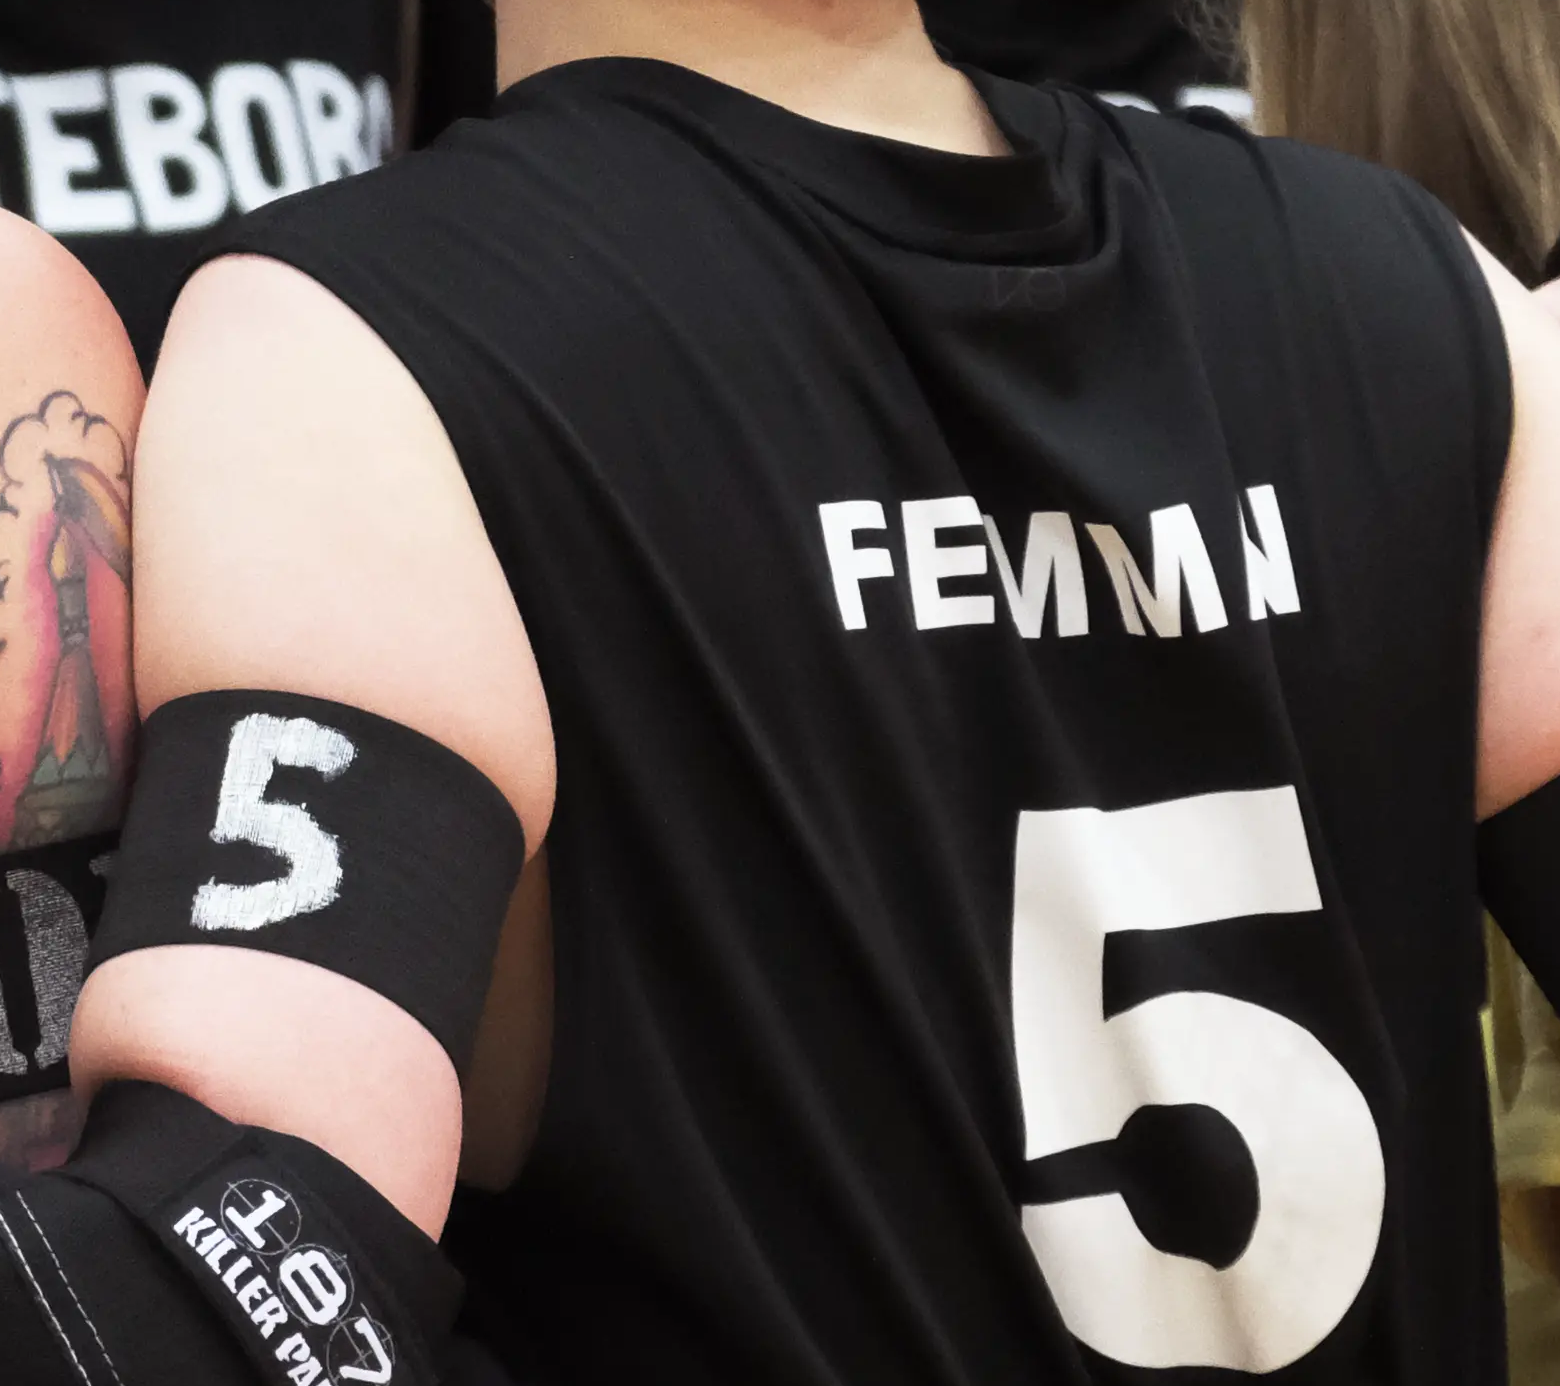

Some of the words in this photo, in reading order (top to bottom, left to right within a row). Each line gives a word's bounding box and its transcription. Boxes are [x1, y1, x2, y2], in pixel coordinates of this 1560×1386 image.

[190, 712, 357, 932] 5
[1011, 784, 1386, 1374] 5
[173, 1206, 289, 1340] KILLER
[224, 1189, 394, 1386] 187
